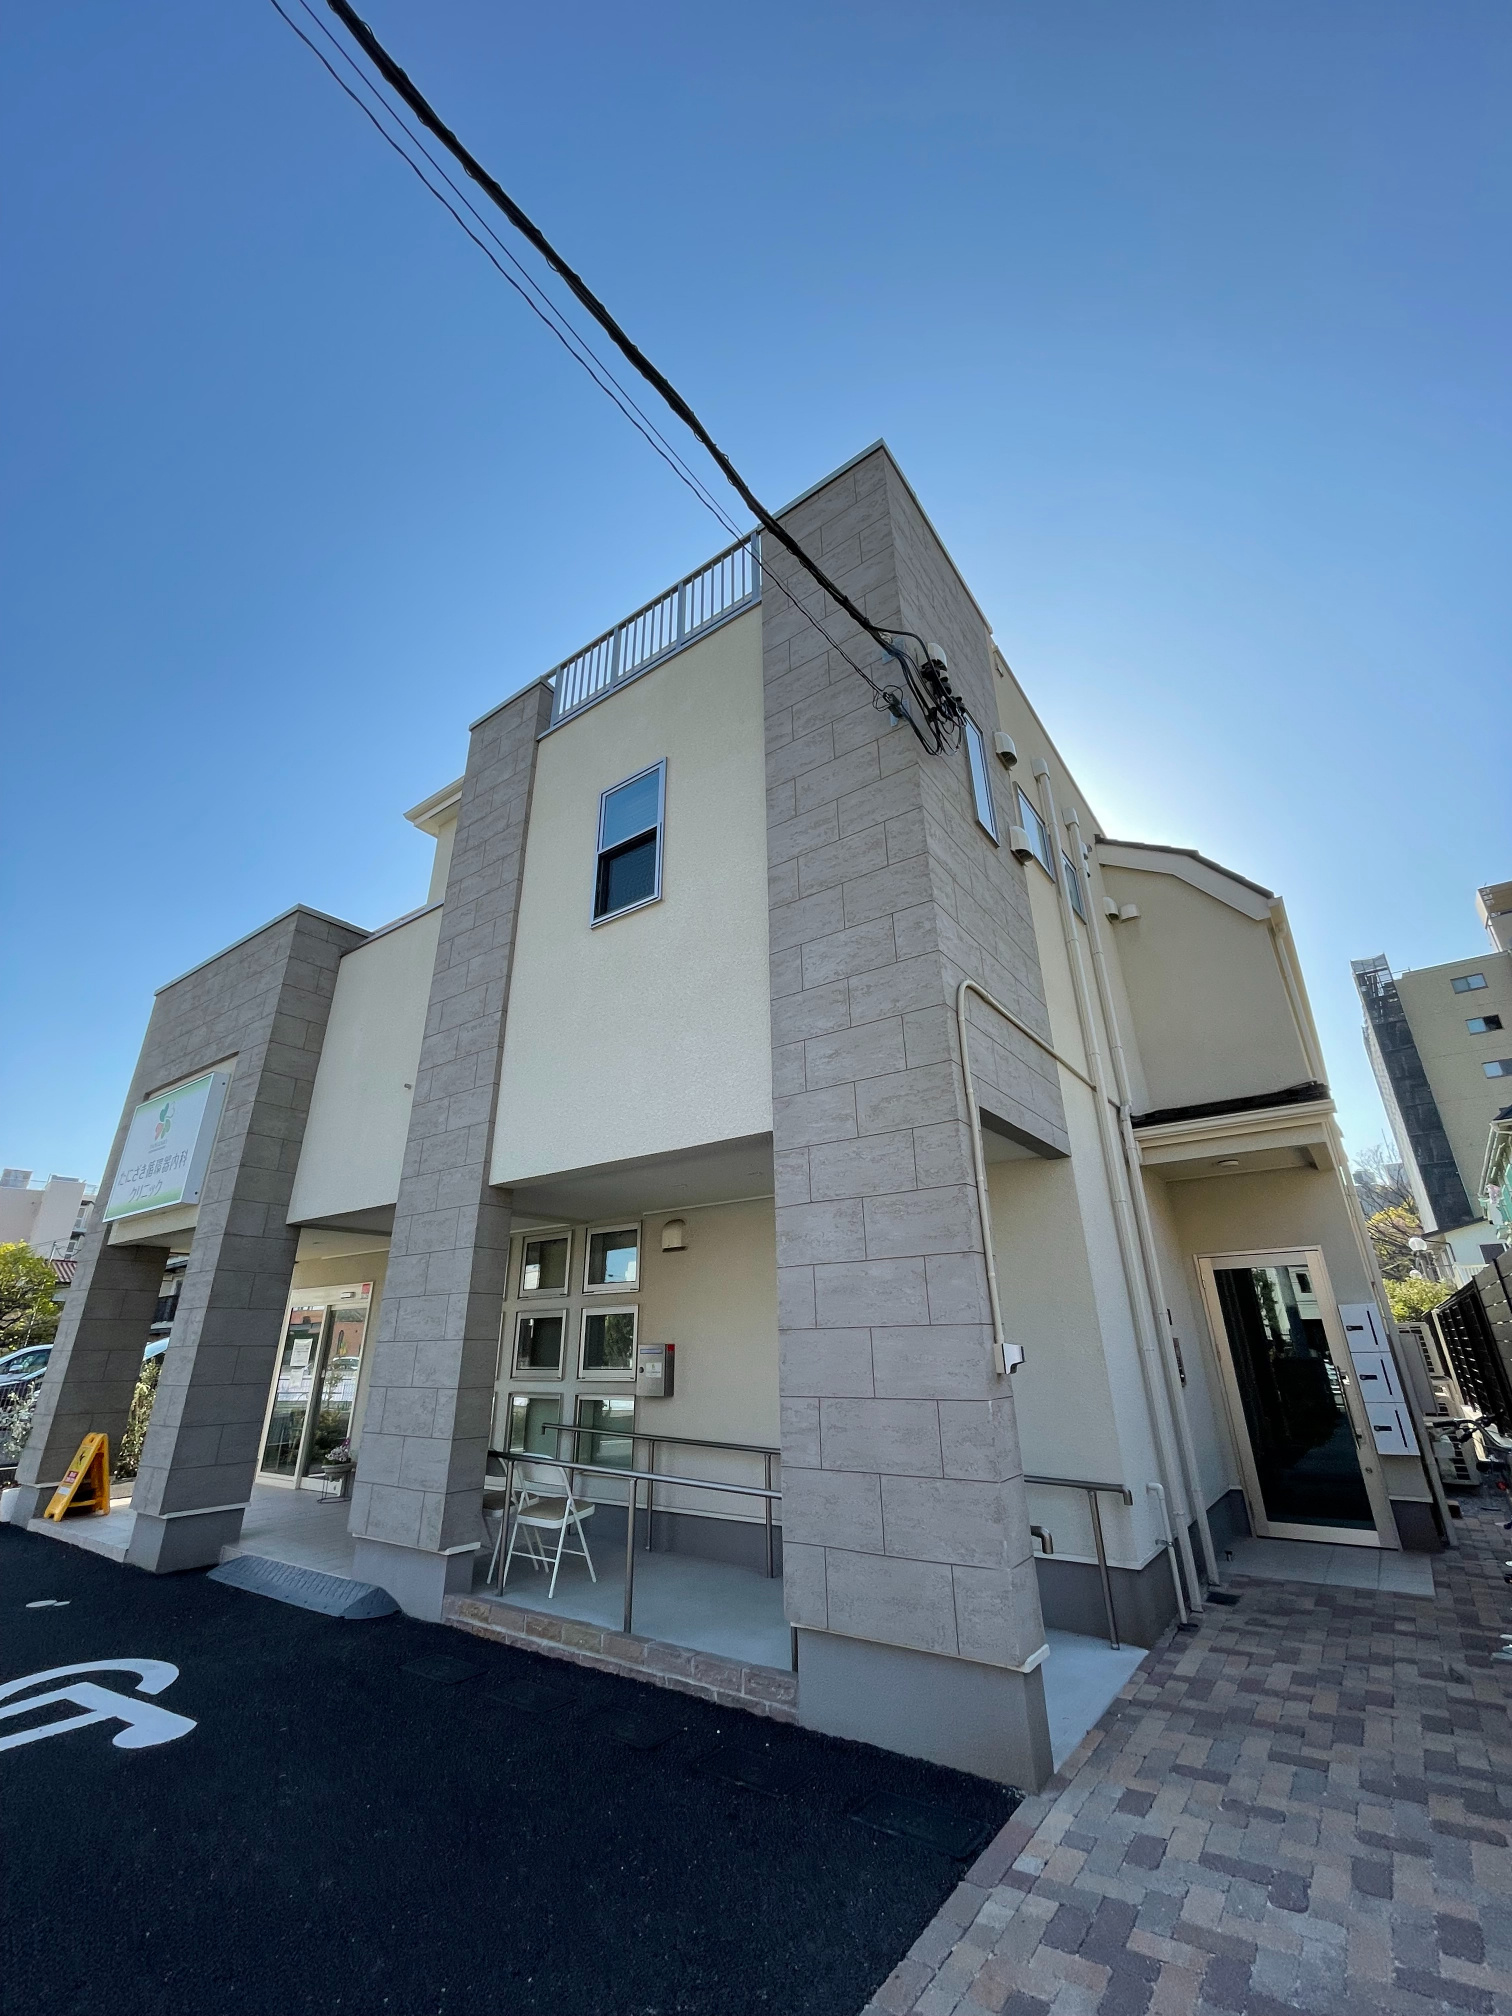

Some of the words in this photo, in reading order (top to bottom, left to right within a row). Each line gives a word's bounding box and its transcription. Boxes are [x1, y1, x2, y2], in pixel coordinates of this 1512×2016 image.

[118, 1149, 188, 1186] たにざき循環器内科
[129, 1179, 163, 1203] クリニック
